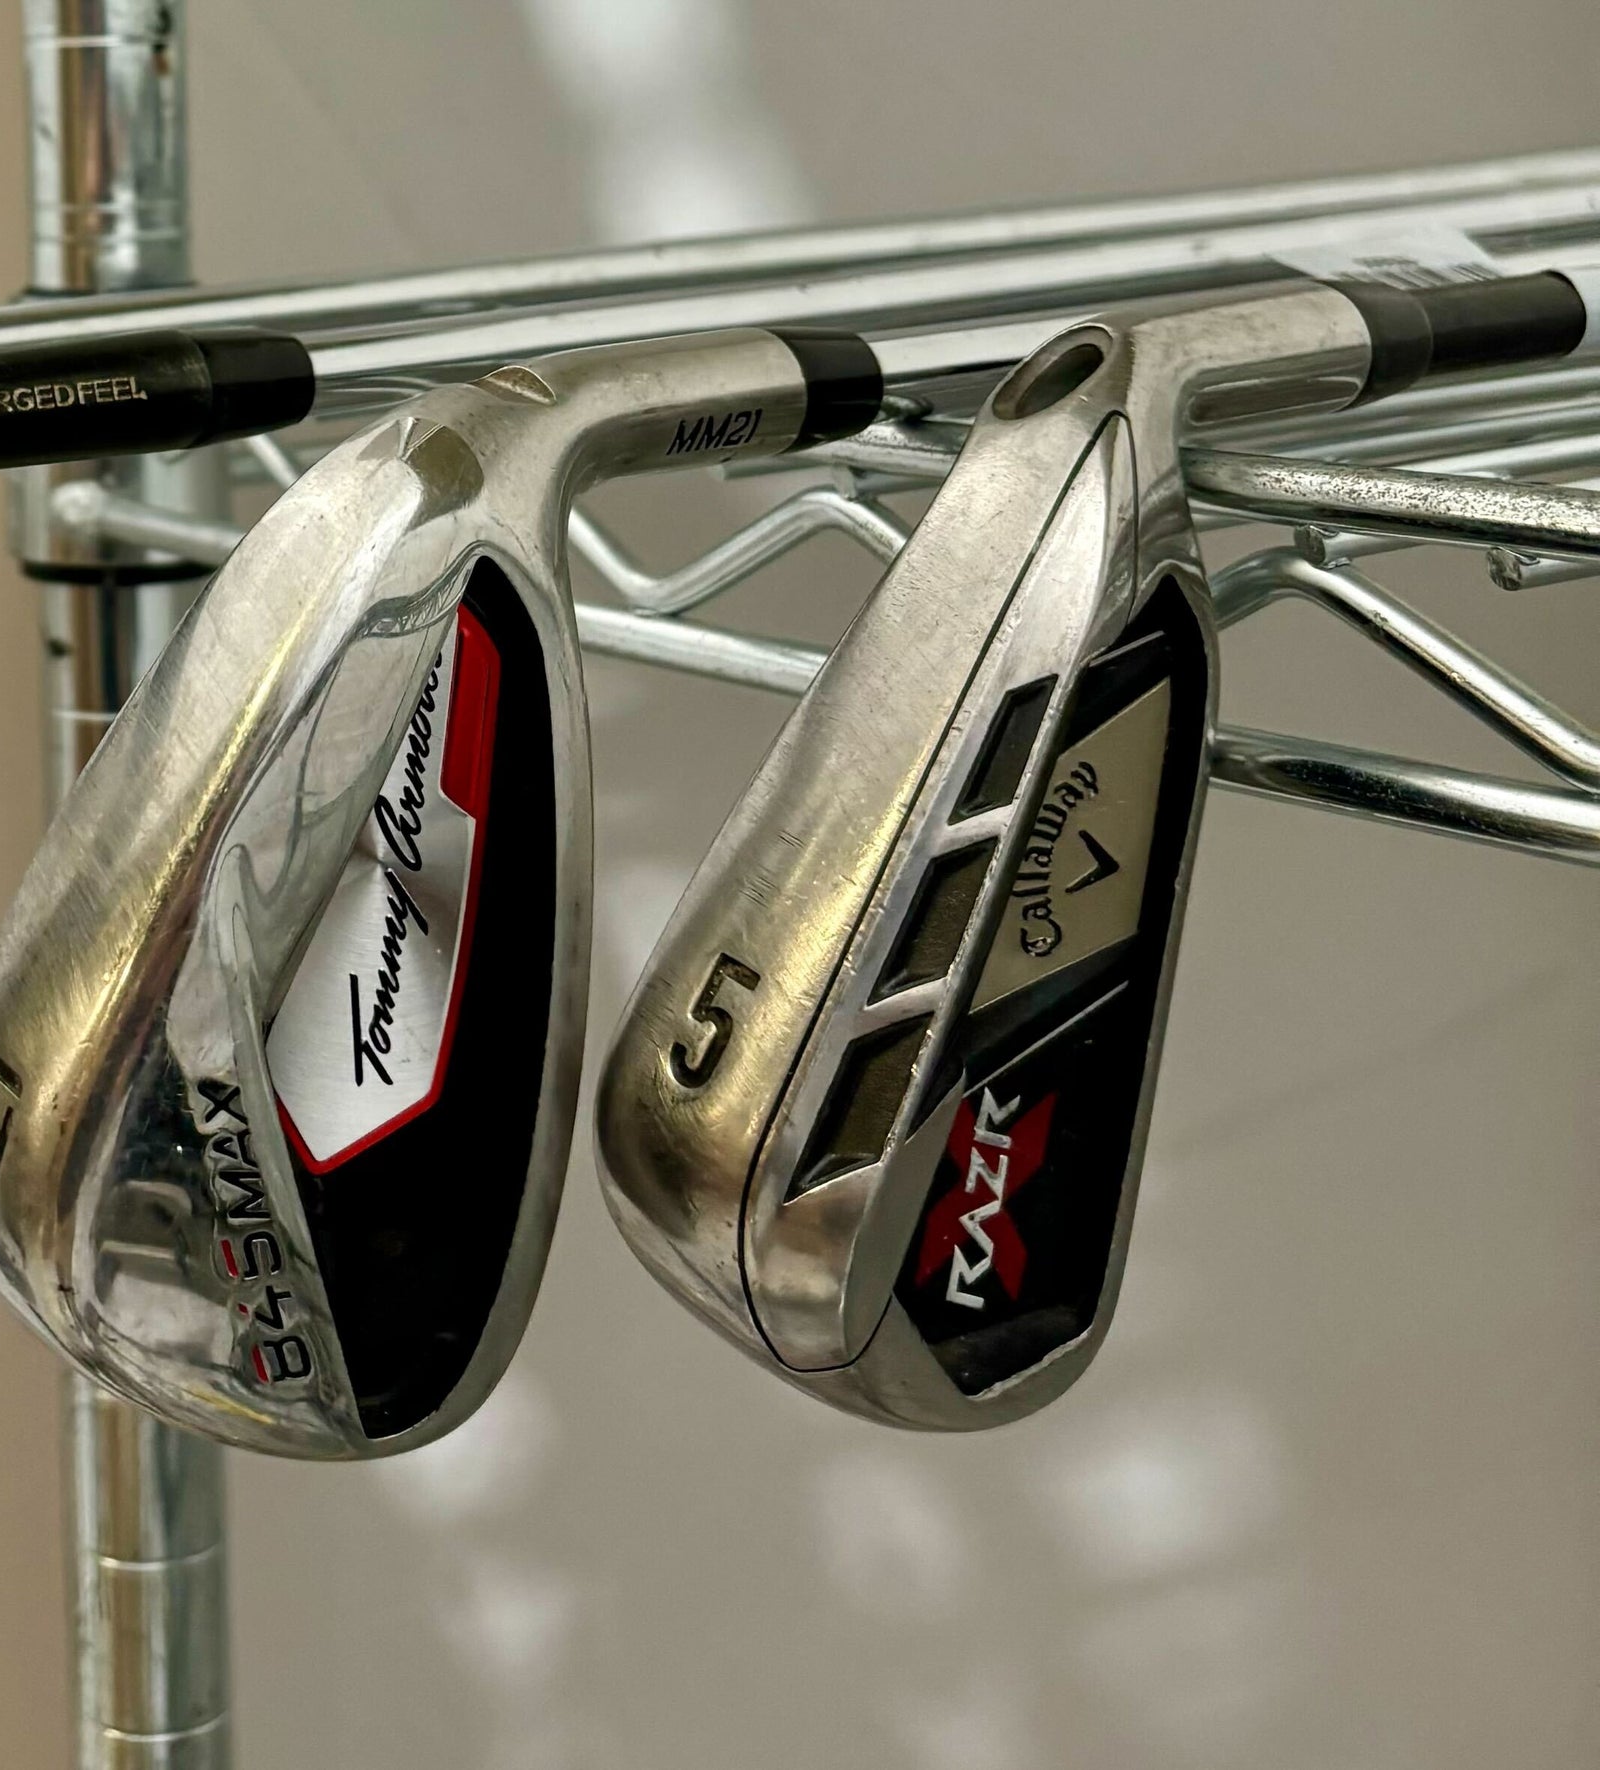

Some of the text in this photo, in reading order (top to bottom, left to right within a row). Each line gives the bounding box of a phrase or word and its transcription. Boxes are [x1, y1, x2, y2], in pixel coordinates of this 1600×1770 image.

[76, 375, 149, 406] FEEL
[664, 407, 764, 456] MM21
[1011, 760, 1100, 958] Callaway
[348, 866, 430, 1088] Tommy
[670, 953, 761, 1090] 5
[944, 1086, 1022, 1310] RAZR
